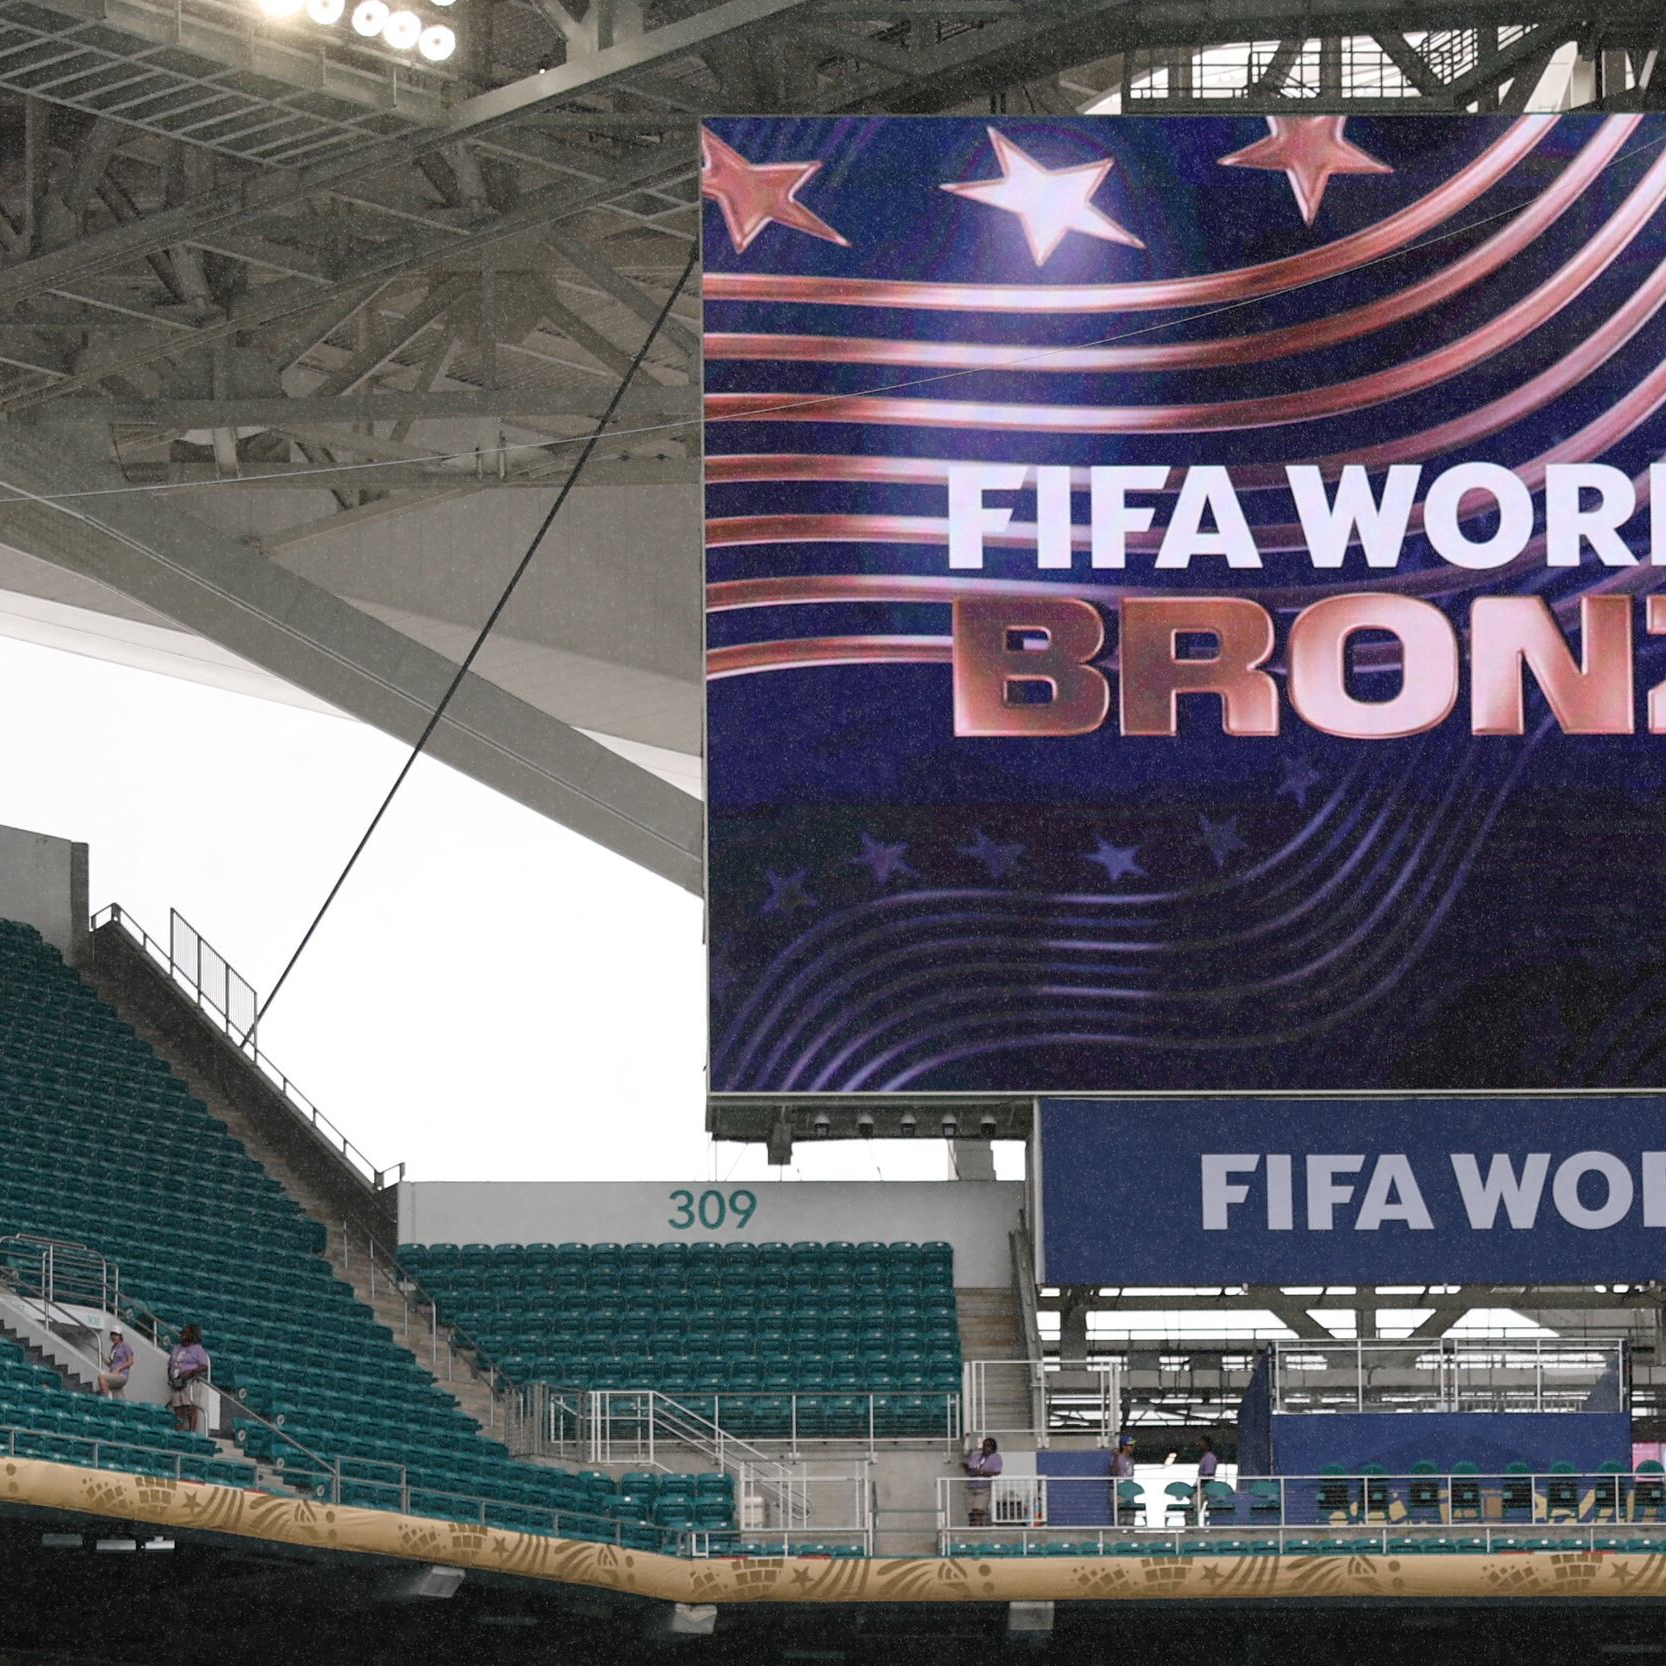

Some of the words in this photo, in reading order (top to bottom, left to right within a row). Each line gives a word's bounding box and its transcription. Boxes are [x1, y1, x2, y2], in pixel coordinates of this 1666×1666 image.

[946, 463, 1260, 570] FIFA
[668, 1188, 758, 1231] 309
[1202, 1154, 1434, 1230] FIFA
